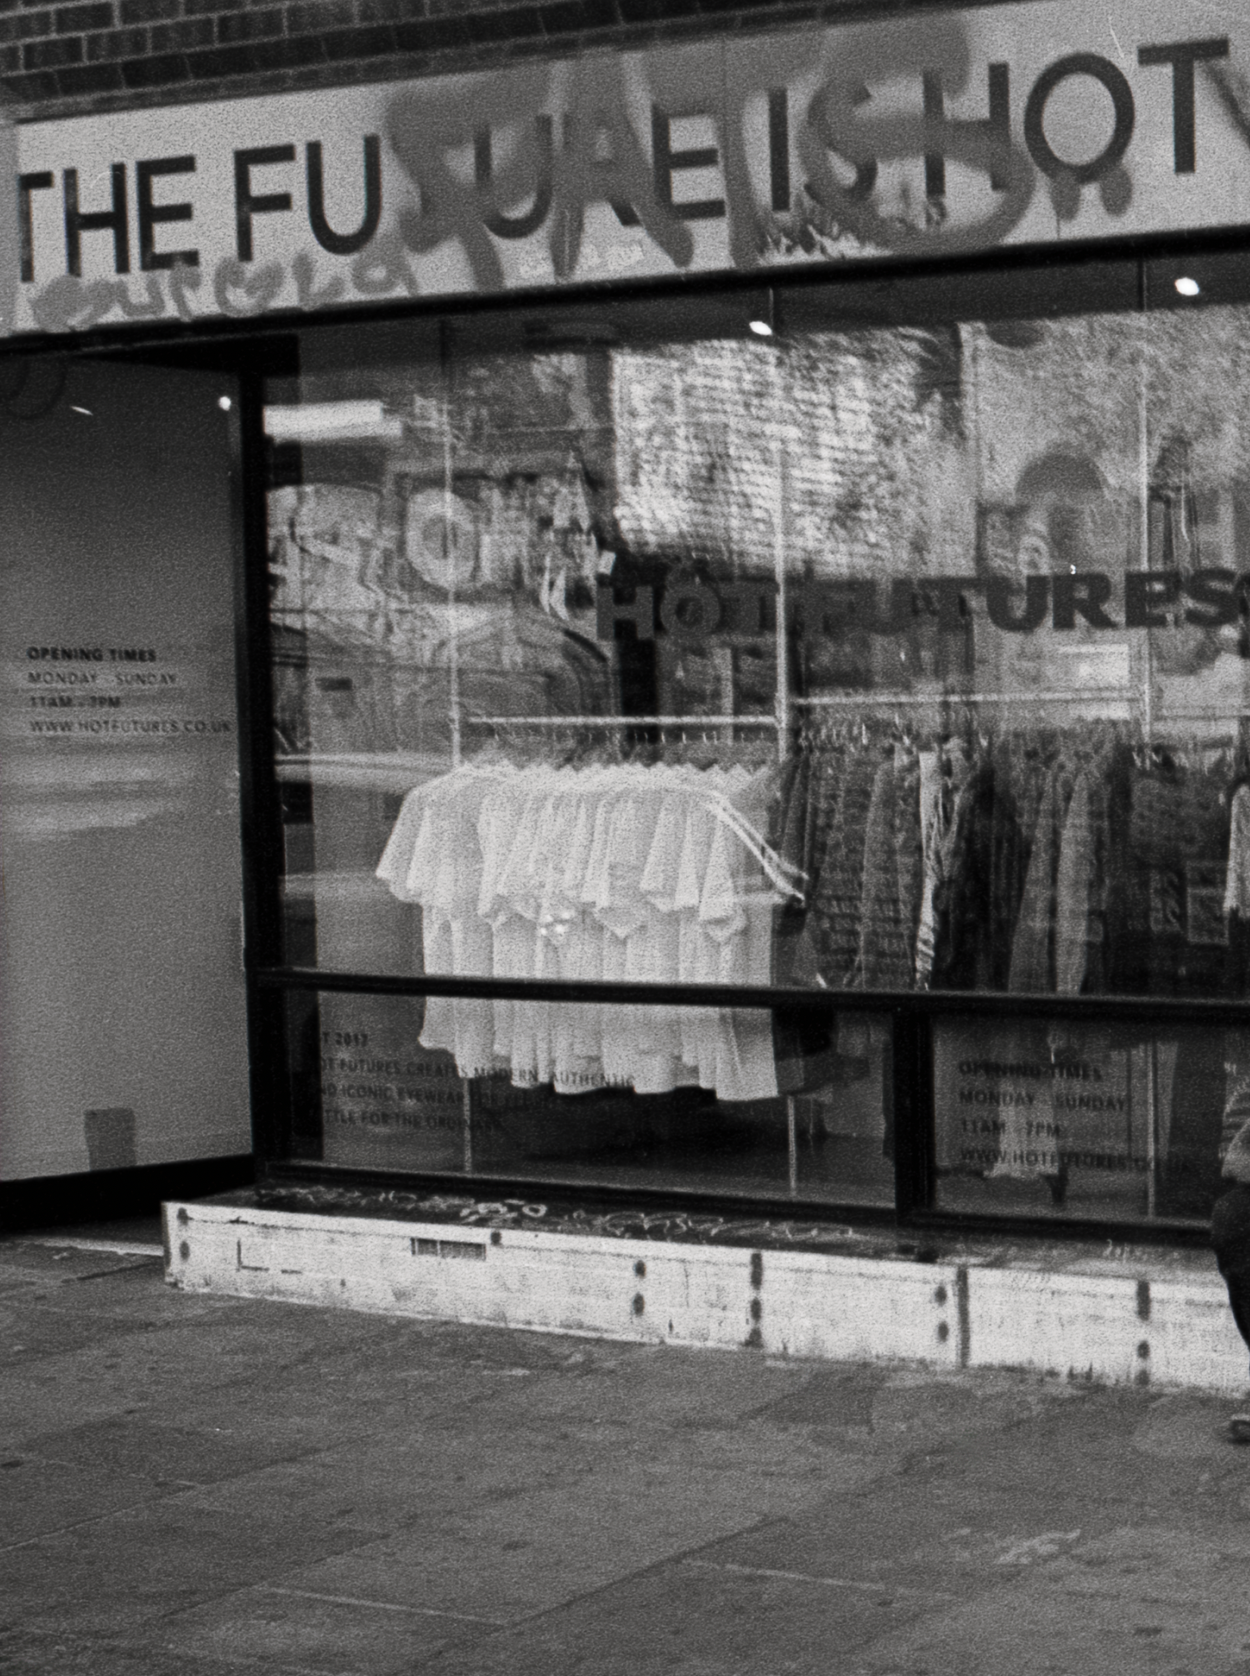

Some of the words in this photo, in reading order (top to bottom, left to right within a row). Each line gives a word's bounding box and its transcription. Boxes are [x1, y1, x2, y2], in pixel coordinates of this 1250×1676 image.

[18, 155, 200, 283] THE
[921, 35, 1230, 200] HOT
[27, 646, 104, 661] OPENING
[109, 648, 157, 662] TIMES
[27, 672, 97, 685] MONDAY
[115, 672, 177, 686] SUNDAY
[30, 696, 73, 707] 11AM
[959, 1090, 1035, 1107] MONDAY
